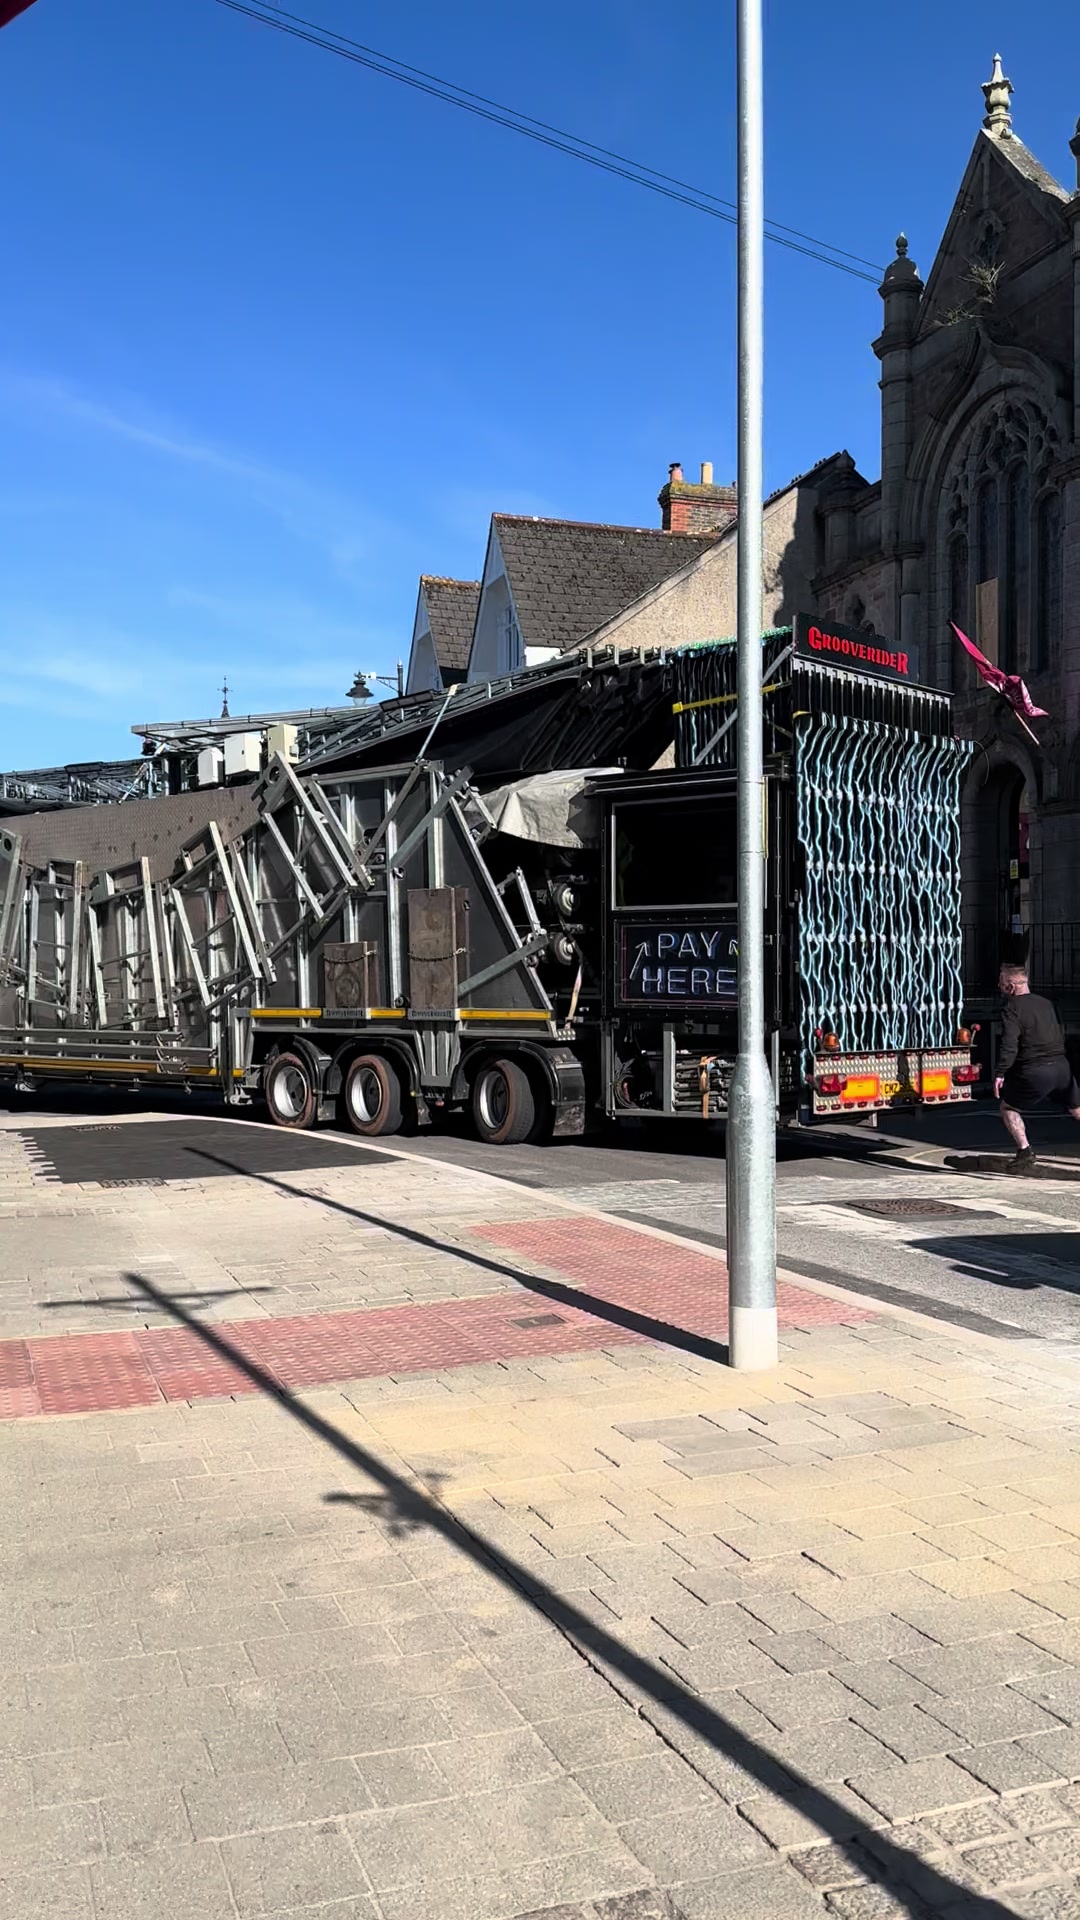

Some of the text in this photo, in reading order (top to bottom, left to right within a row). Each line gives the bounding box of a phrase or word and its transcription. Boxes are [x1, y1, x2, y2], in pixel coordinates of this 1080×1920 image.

[808, 626, 909, 675] GROOVERIDER
[657, 930, 719, 958] PAY
[642, 967, 737, 995] HERE
